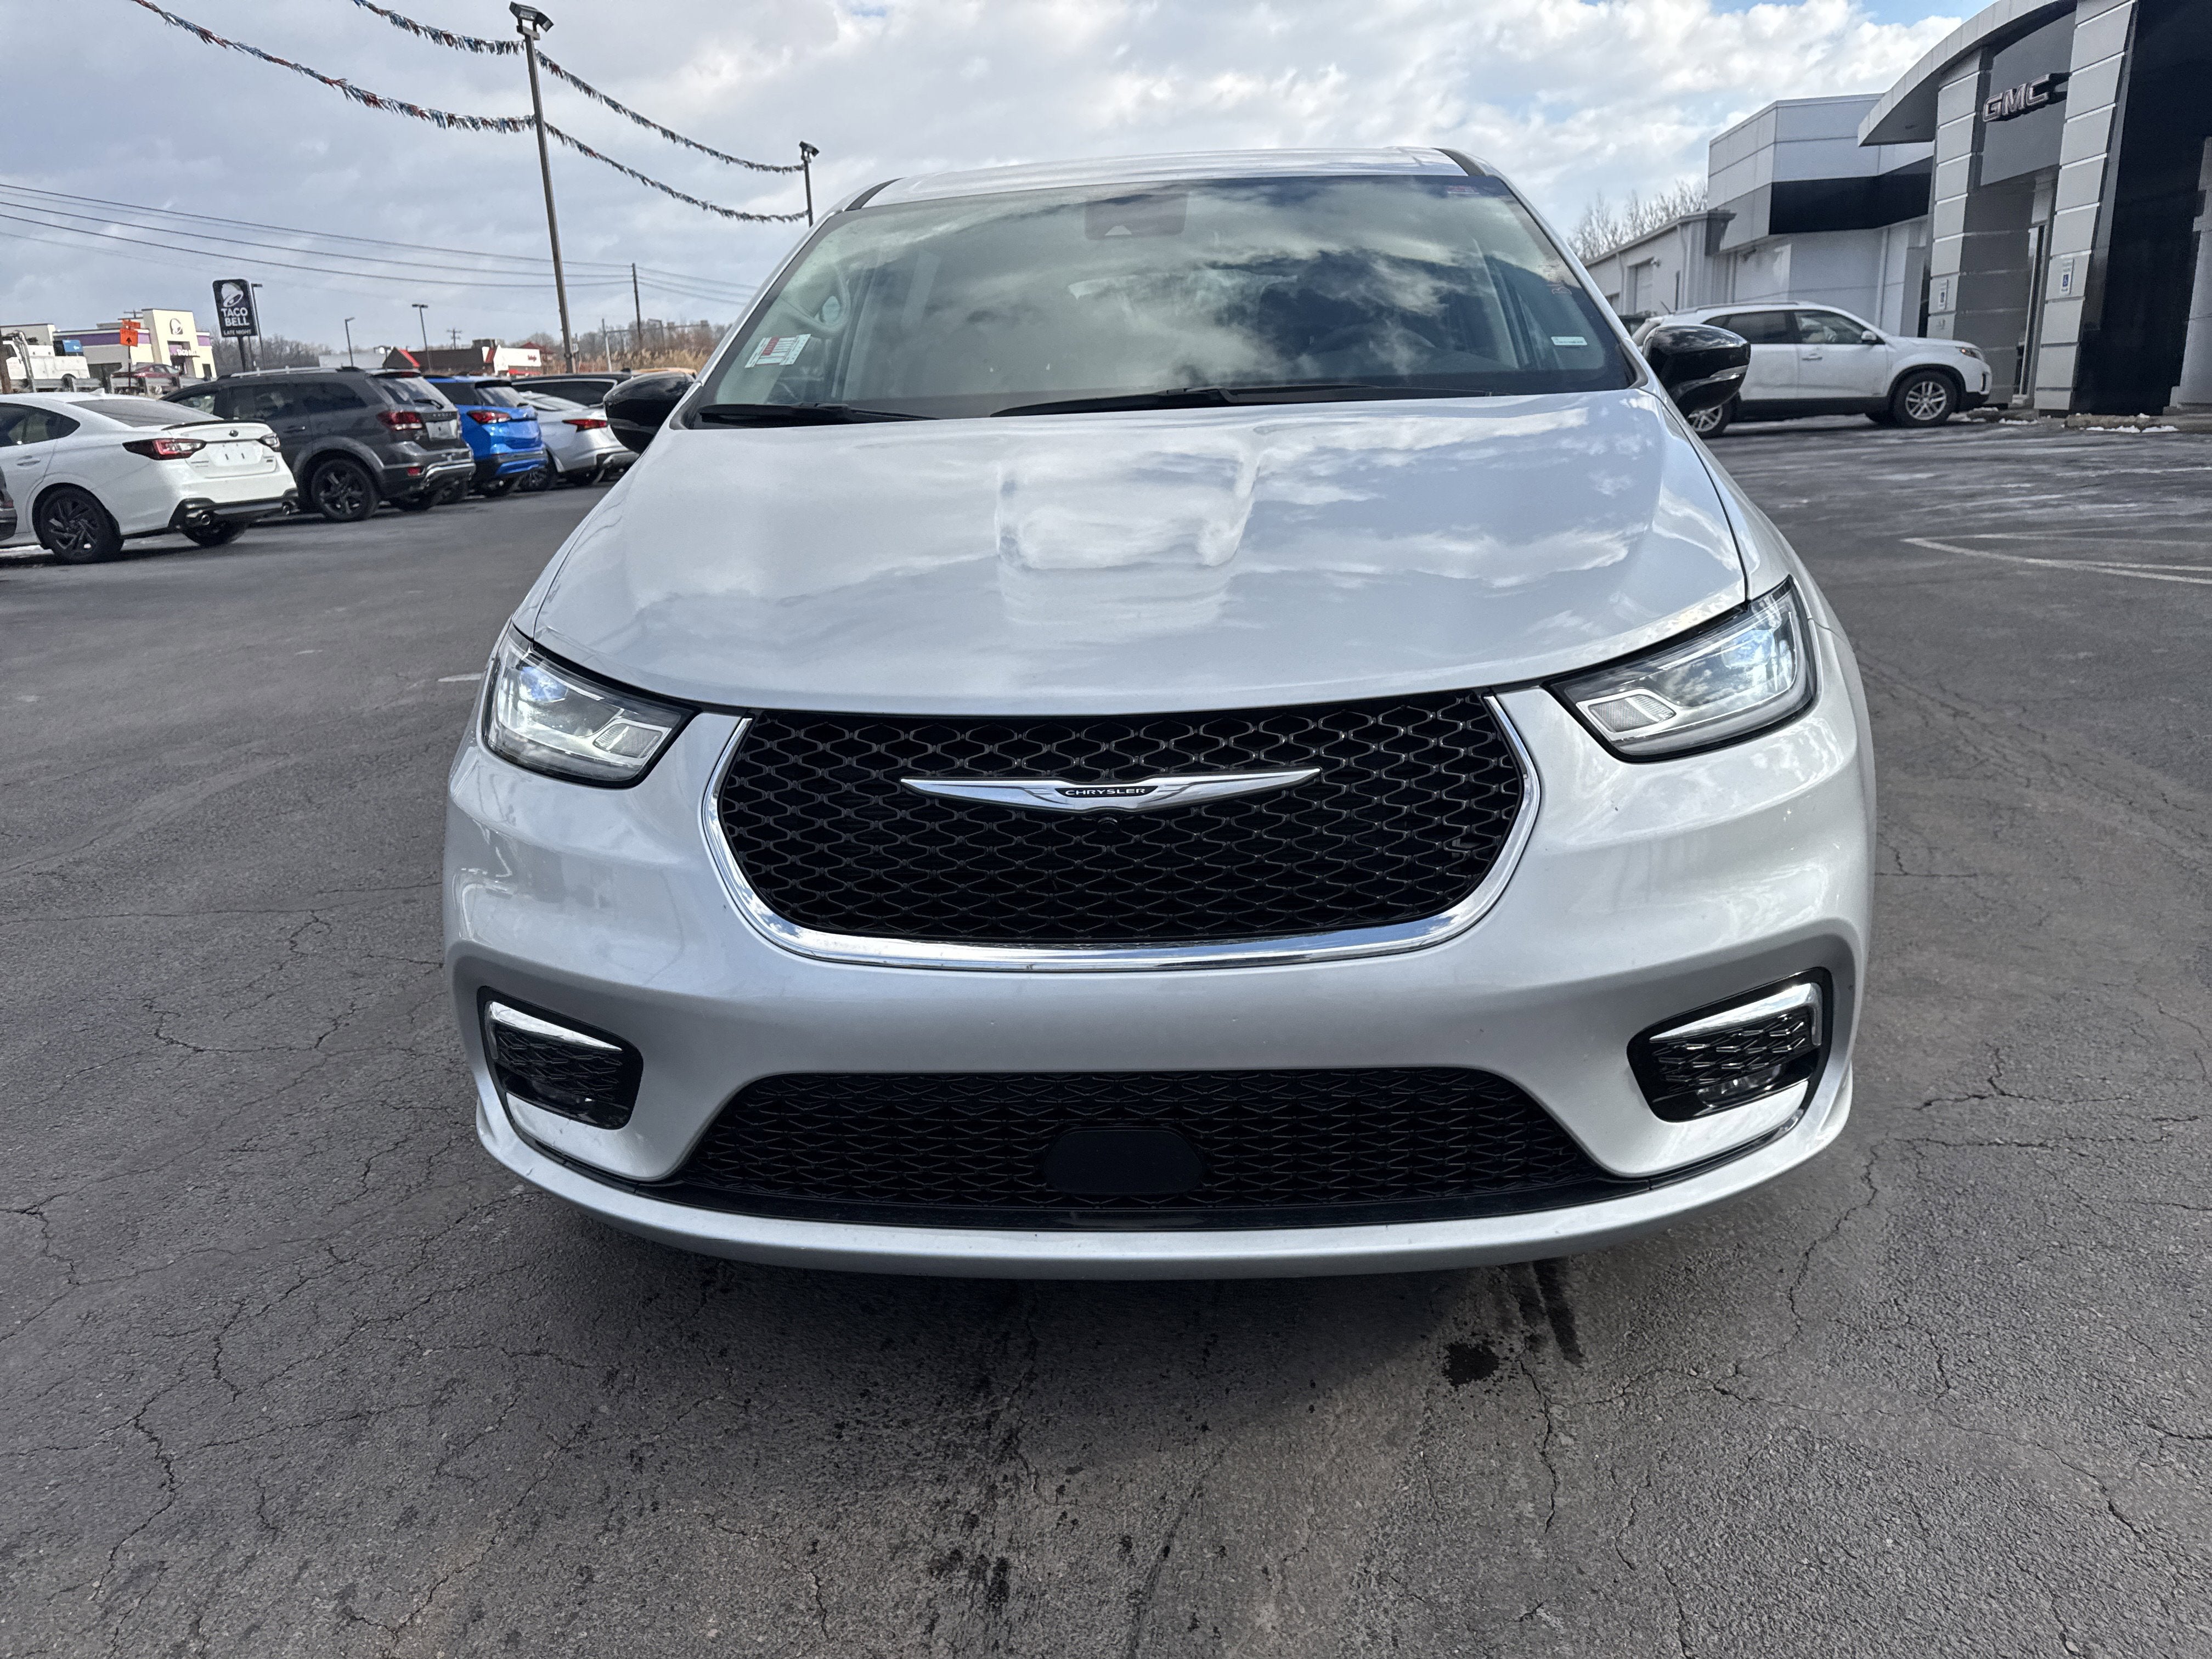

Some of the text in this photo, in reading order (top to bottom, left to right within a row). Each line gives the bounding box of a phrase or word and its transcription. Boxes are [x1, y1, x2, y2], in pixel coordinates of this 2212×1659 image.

[1982, 74, 2050, 122] GMC
[221, 307, 248, 317] TACO
[224, 317, 250, 326] BELL
